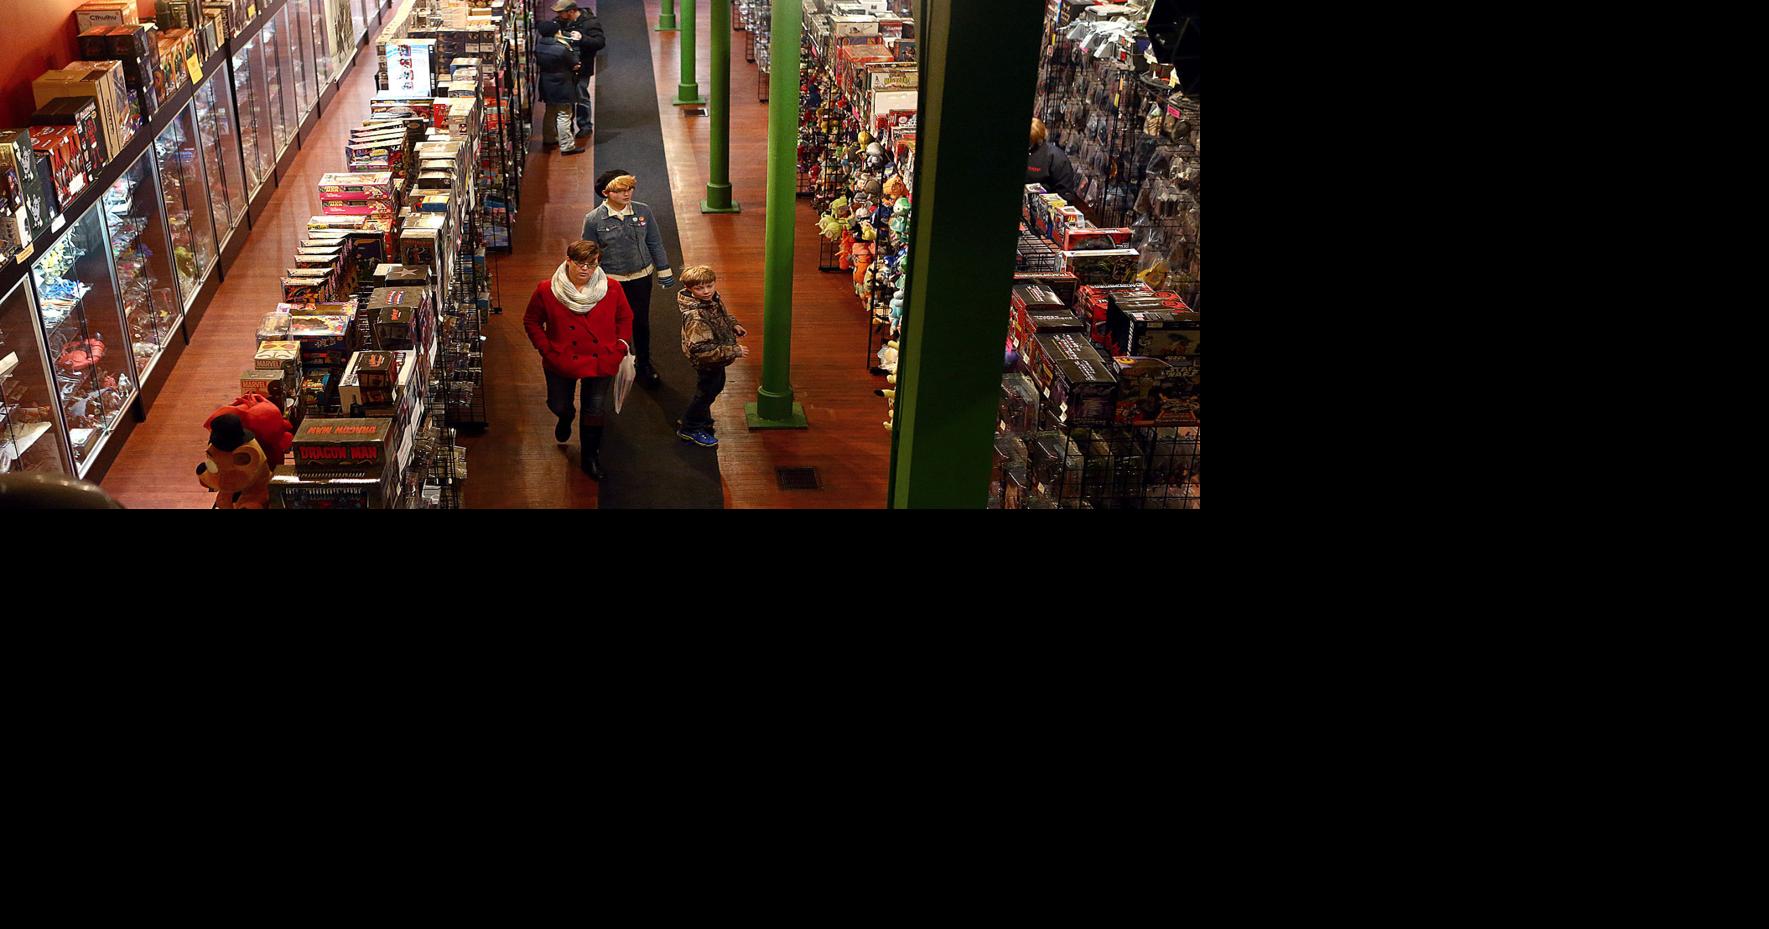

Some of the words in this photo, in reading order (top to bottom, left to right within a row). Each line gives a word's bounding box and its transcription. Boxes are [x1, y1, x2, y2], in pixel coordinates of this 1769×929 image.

[256, 360, 281, 368] MARVEL
[300, 446, 347, 459] DRAGON
[350, 446, 377, 459] MAN
